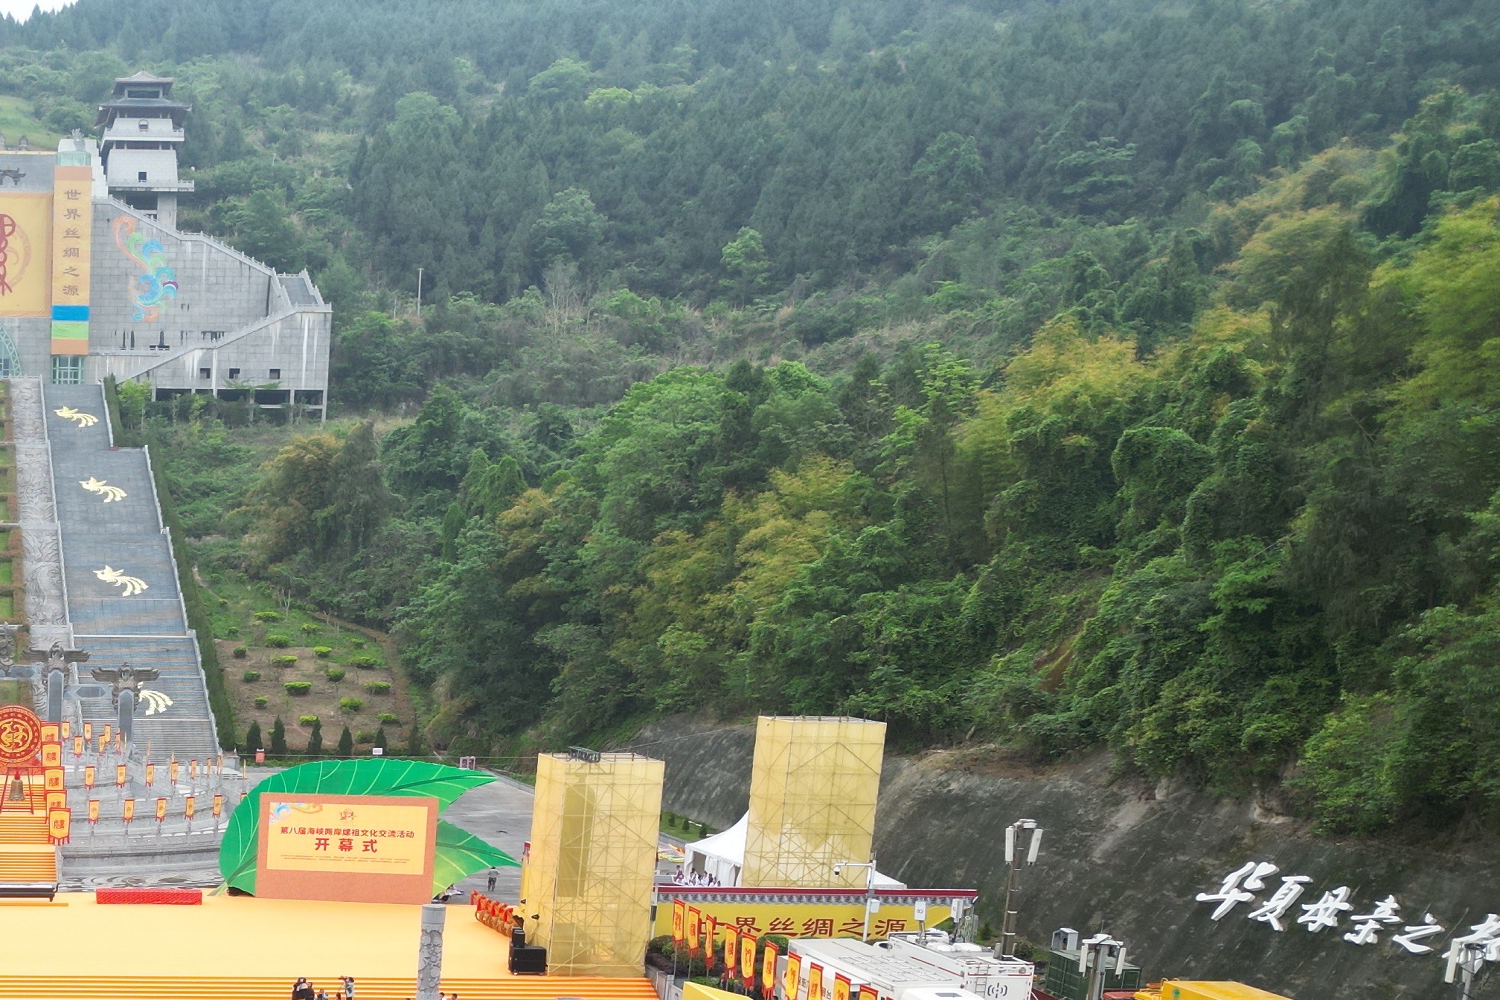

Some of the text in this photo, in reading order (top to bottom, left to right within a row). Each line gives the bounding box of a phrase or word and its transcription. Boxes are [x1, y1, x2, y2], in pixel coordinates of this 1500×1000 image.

[62, 189, 81, 296] 世界丝绸之源
[314, 838, 378, 853] 开幕式
